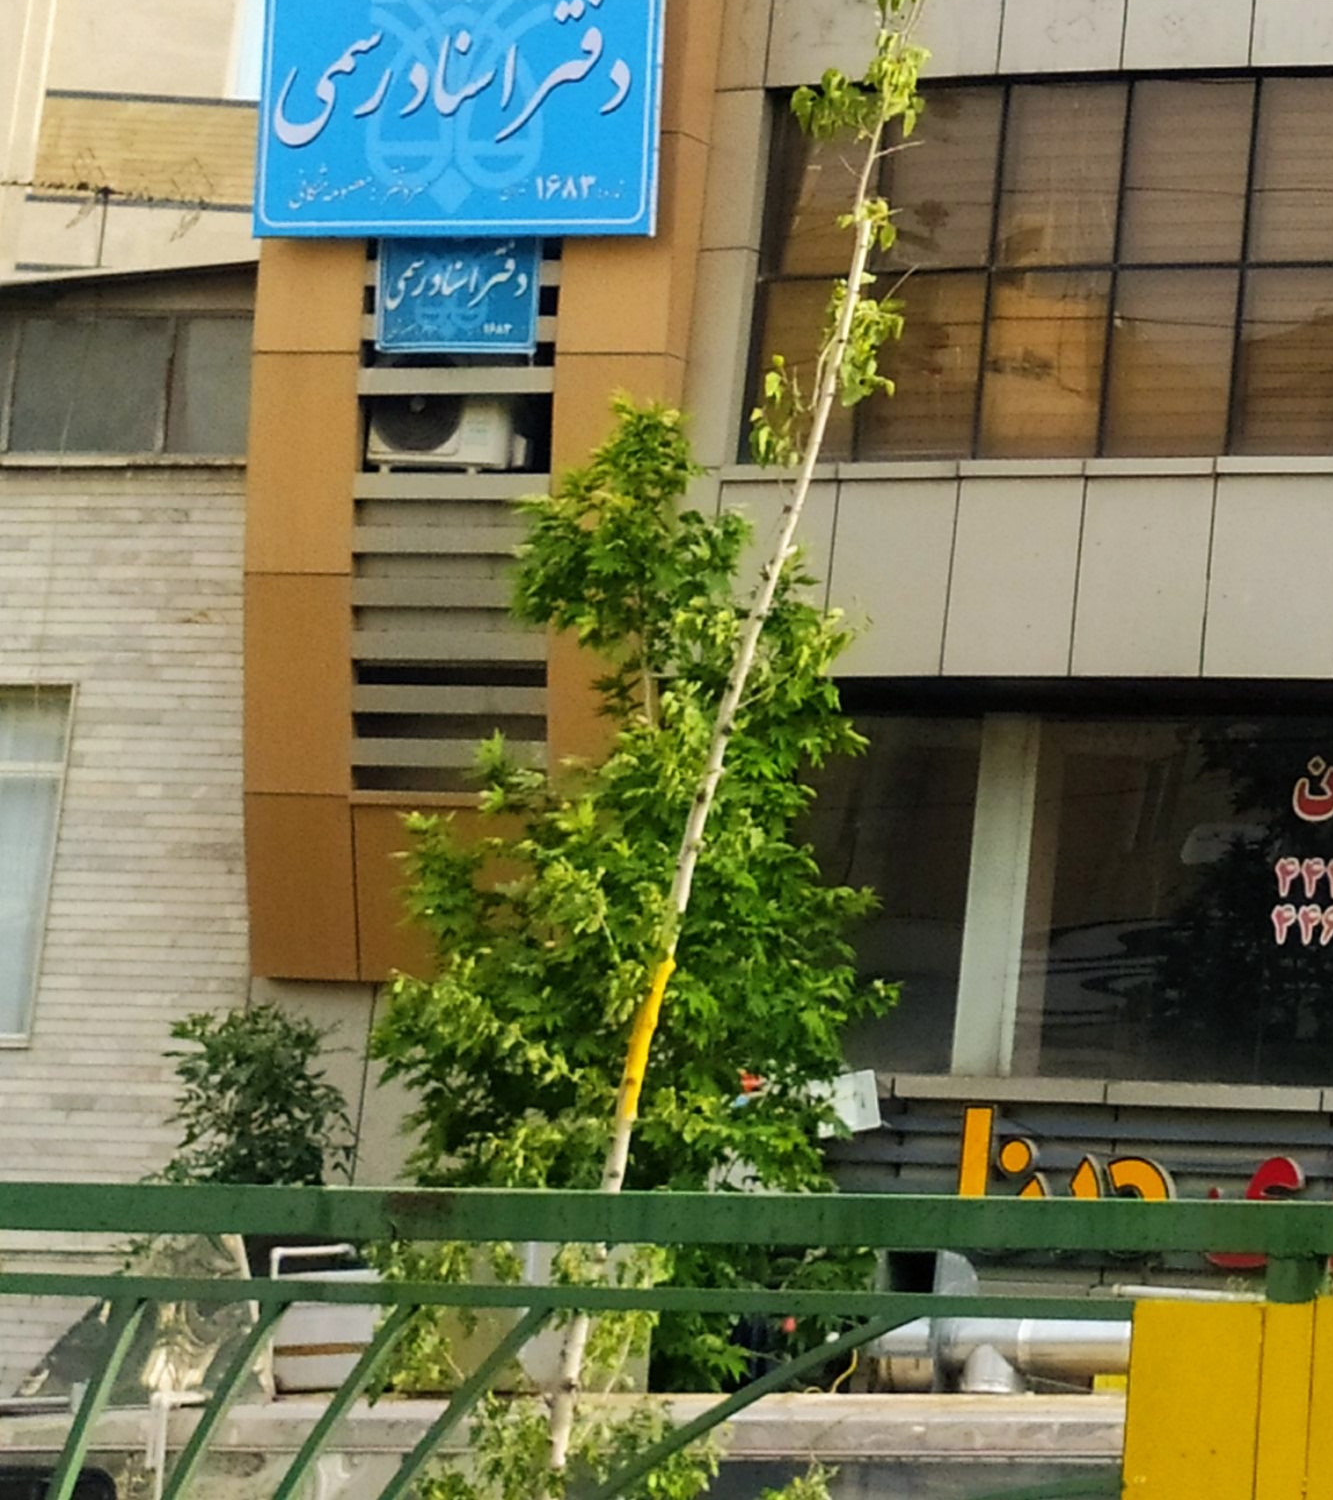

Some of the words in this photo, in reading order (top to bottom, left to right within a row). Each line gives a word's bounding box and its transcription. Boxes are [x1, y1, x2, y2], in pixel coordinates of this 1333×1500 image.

[273, 30, 393, 148] رسمی
[400, 30, 519, 117] اسناد
[534, 174, 598, 202] ۱۶۸۳
[385, 259, 427, 311] رسمی
[428, 261, 479, 297] اسناد
[467, 240, 528, 308] دفتر
